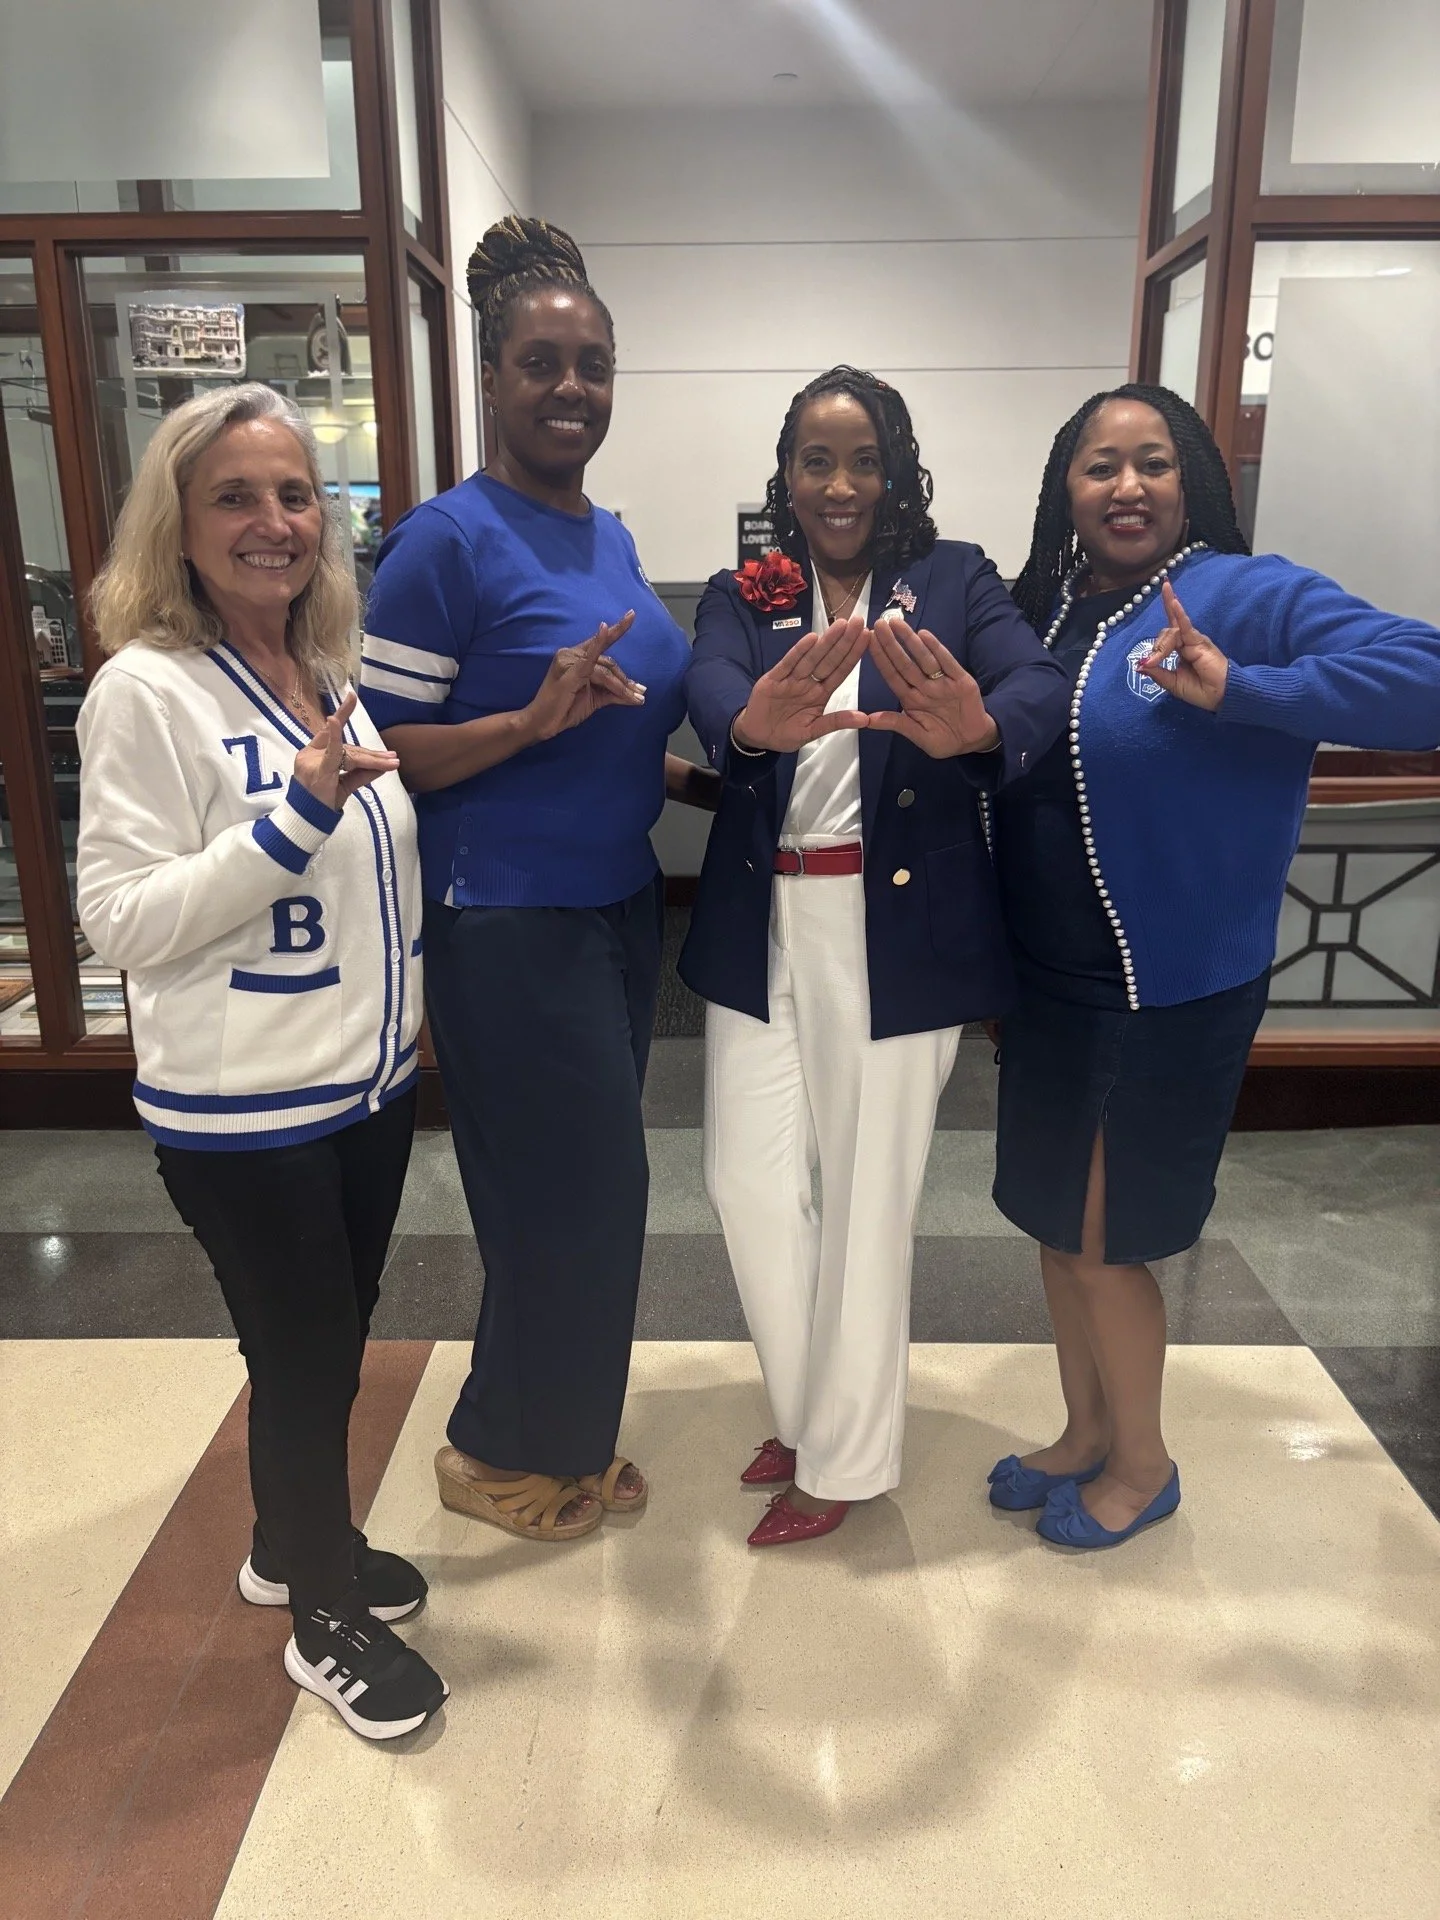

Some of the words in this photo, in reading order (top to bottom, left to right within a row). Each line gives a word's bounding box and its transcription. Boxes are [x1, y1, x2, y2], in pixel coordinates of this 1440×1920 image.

[742, 534, 773, 545] LOVET
[222, 734, 283, 795] Z
[269, 895, 326, 954] B
